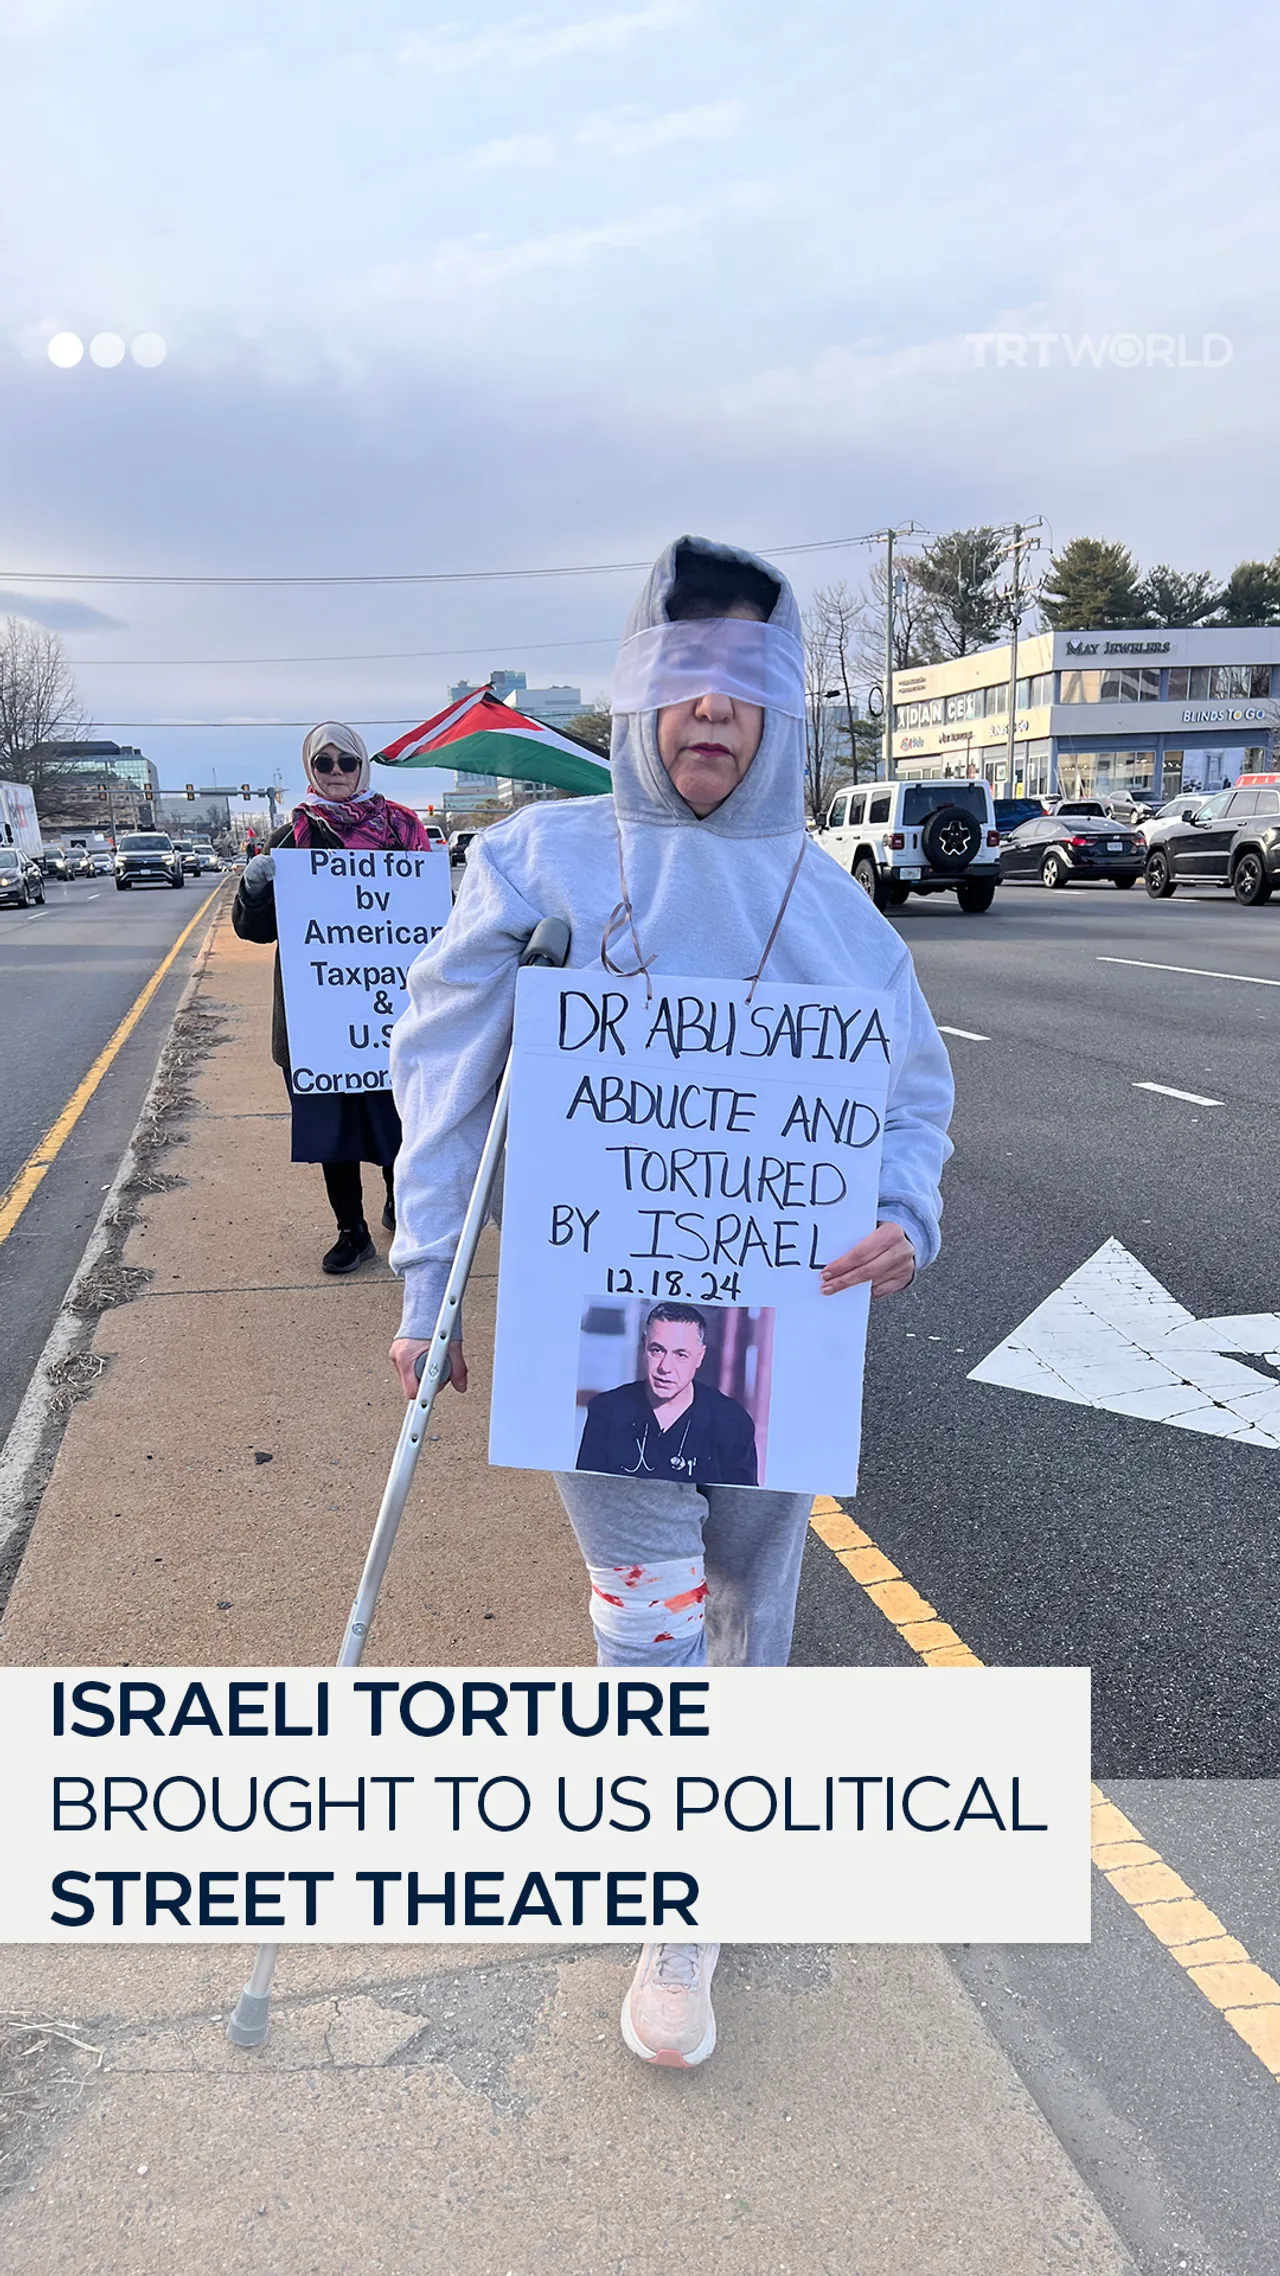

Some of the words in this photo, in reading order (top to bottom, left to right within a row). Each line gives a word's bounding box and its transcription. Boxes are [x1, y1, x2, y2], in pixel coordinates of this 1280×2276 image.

[1066, 638, 1099, 655] MAY
[1103, 641, 1171, 655] JEWELERS
[1182, 709, 1224, 723] BLINDS
[1227, 709, 1242, 721] TO
[1245, 707, 1266, 720] GO
[310, 850, 376, 878] Paid
[383, 852, 425, 878] for
[373, 990, 394, 1015] &
[559, 991, 628, 1055] DR
[645, 996, 737, 1060] ABU
[740, 1003, 892, 1065] SAFIYA
[292, 1068, 392, 1093] Corpor
[566, 1075, 756, 1133] ABDUCTE
[781, 1095, 880, 1149] AND
[605, 1146, 848, 1210] TORTURED
[549, 1205, 600, 1252] BY
[629, 1209, 827, 1271] ISRAEL
[607, 1269, 742, 1301] 12.18.24
